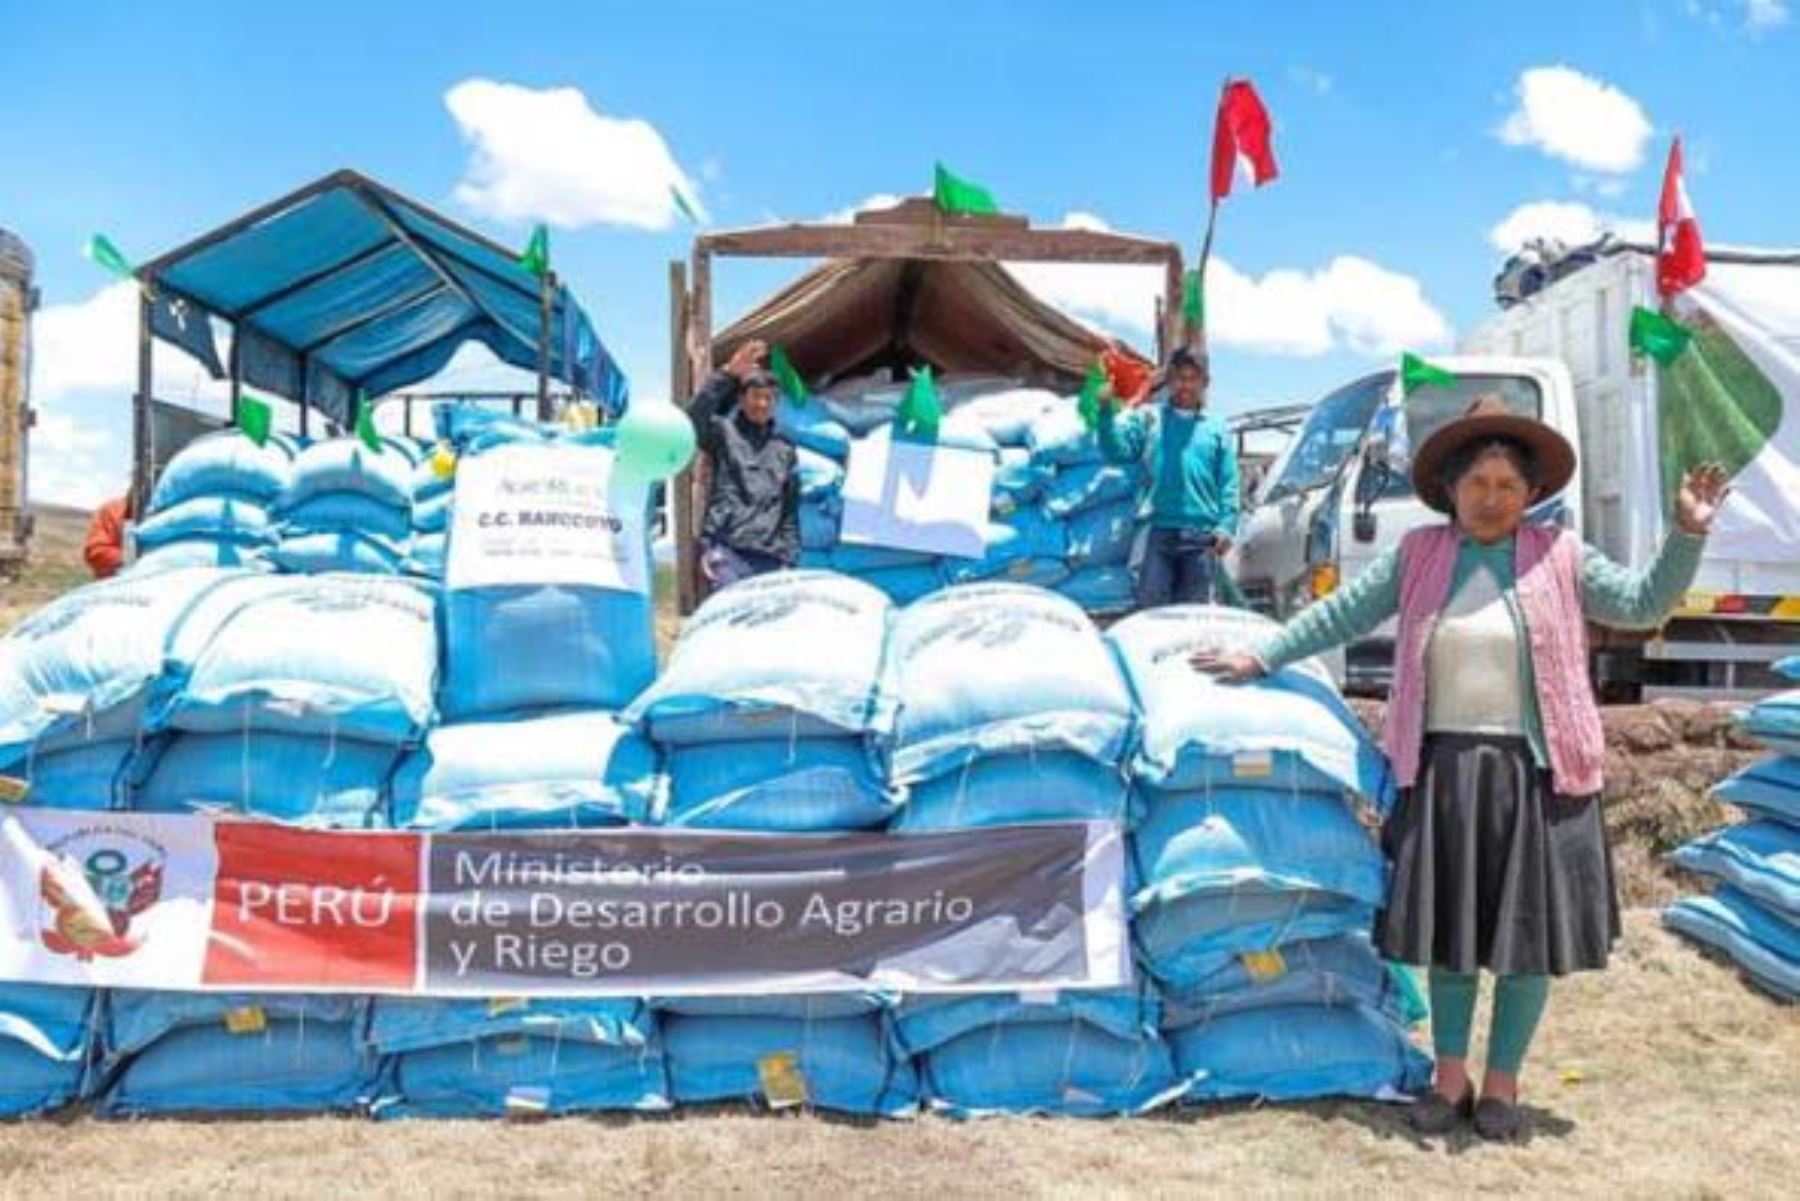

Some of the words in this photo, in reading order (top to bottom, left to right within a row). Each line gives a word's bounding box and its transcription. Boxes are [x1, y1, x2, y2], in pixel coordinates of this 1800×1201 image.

[455, 850, 705, 886] Ministerio
[238, 875, 395, 927] PERÚ
[450, 889, 511, 928] de
[529, 889, 785, 929] Desarrollo
[800, 889, 974, 936] Agrario
[450, 939, 478, 977] y
[494, 933, 632, 978] Riego
